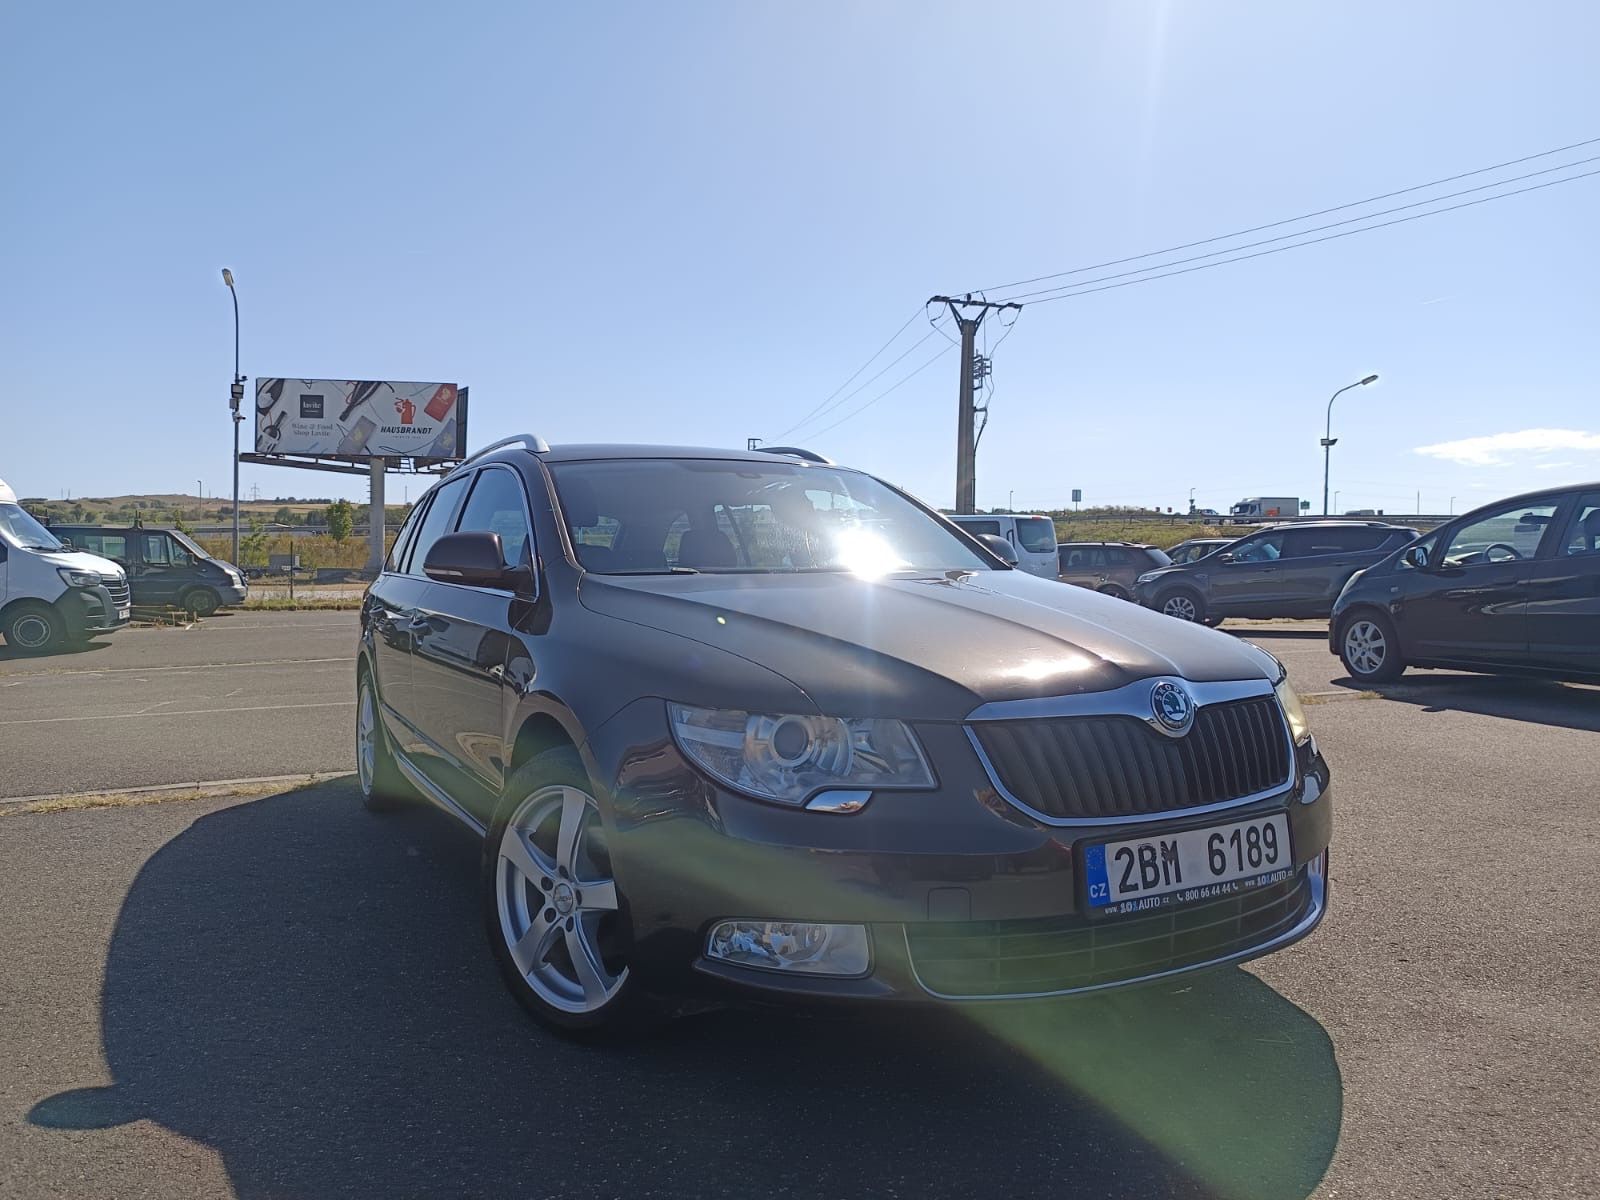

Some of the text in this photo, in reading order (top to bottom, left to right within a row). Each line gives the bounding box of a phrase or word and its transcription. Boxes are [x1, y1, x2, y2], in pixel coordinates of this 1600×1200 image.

[380, 426, 433, 434] HAUSBRANDT
[1114, 822, 1279, 894] 2BM 6189
[1089, 882, 1107, 899] CZ
[1185, 890, 1199, 901] 800
[1200, 887, 1210, 898] 66
[1211, 885, 1220, 895] 44
[1221, 883, 1231, 894] 44
